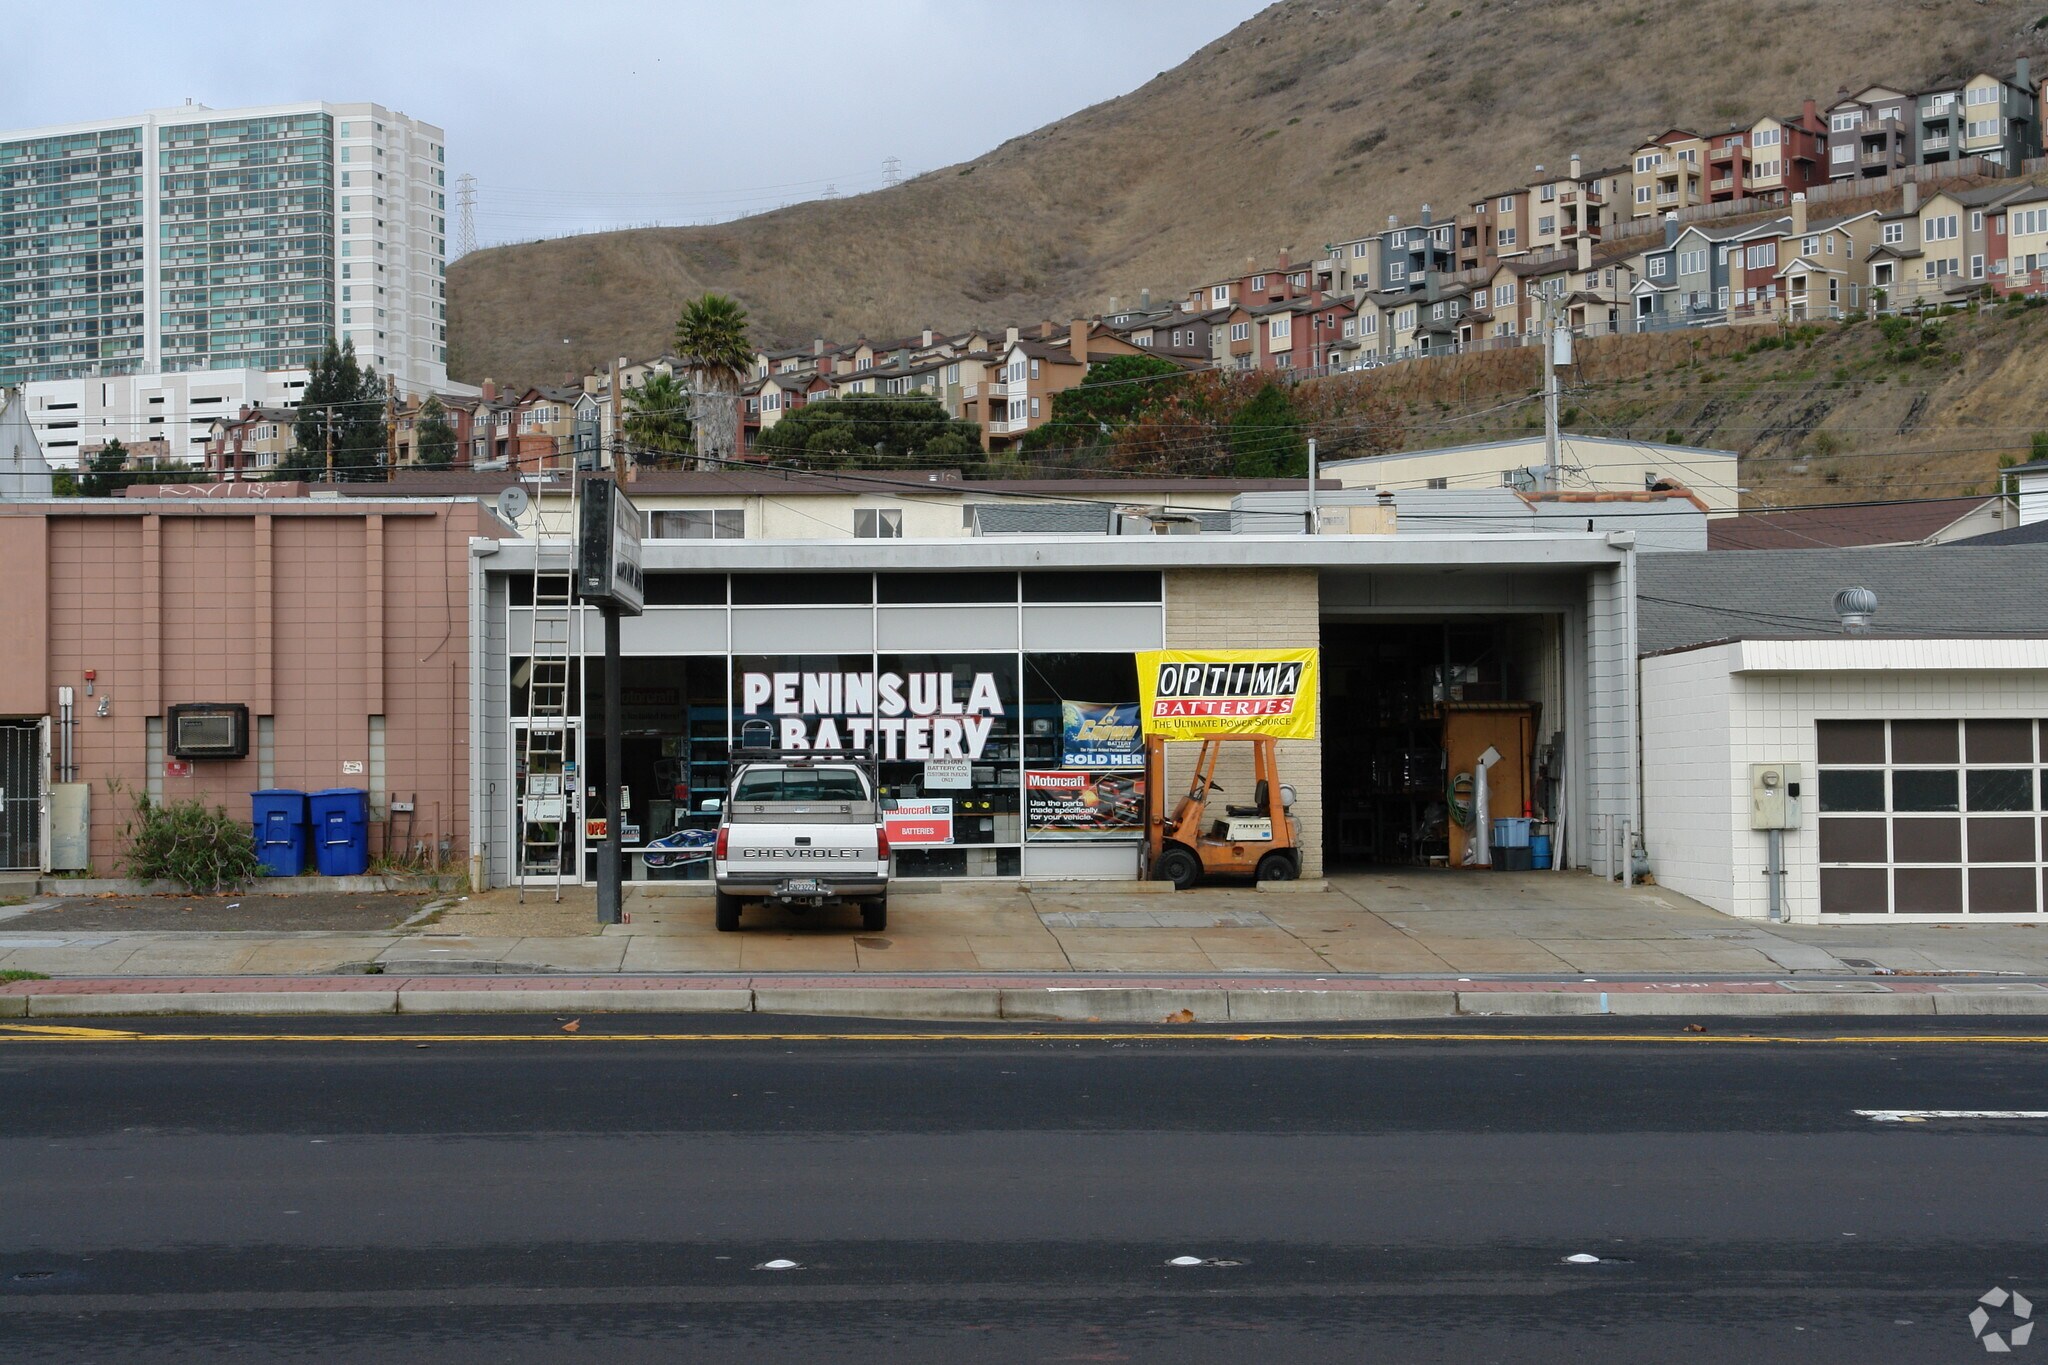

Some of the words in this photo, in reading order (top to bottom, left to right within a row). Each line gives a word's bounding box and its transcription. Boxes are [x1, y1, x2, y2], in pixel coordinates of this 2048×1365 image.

[1159, 666, 1295, 695] OPTIMA
[743, 672, 1004, 716] PENINSULA
[1155, 699, 1293, 716] BATTERIES
[780, 717, 995, 759] BATTERY
[1065, 754, 1108, 765] SOLD
[1110, 754, 1145, 765] HER
[1029, 775, 1085, 787] Motorcraft
[1062, 800, 1084, 808] parts
[1054, 807, 1098, 815] specifically
[1063, 813, 1093, 821] vehicle.
[587, 822, 606, 836] OPE
[901, 827, 935, 835] BATTERIES
[743, 849, 863, 859] CHEVROLET
